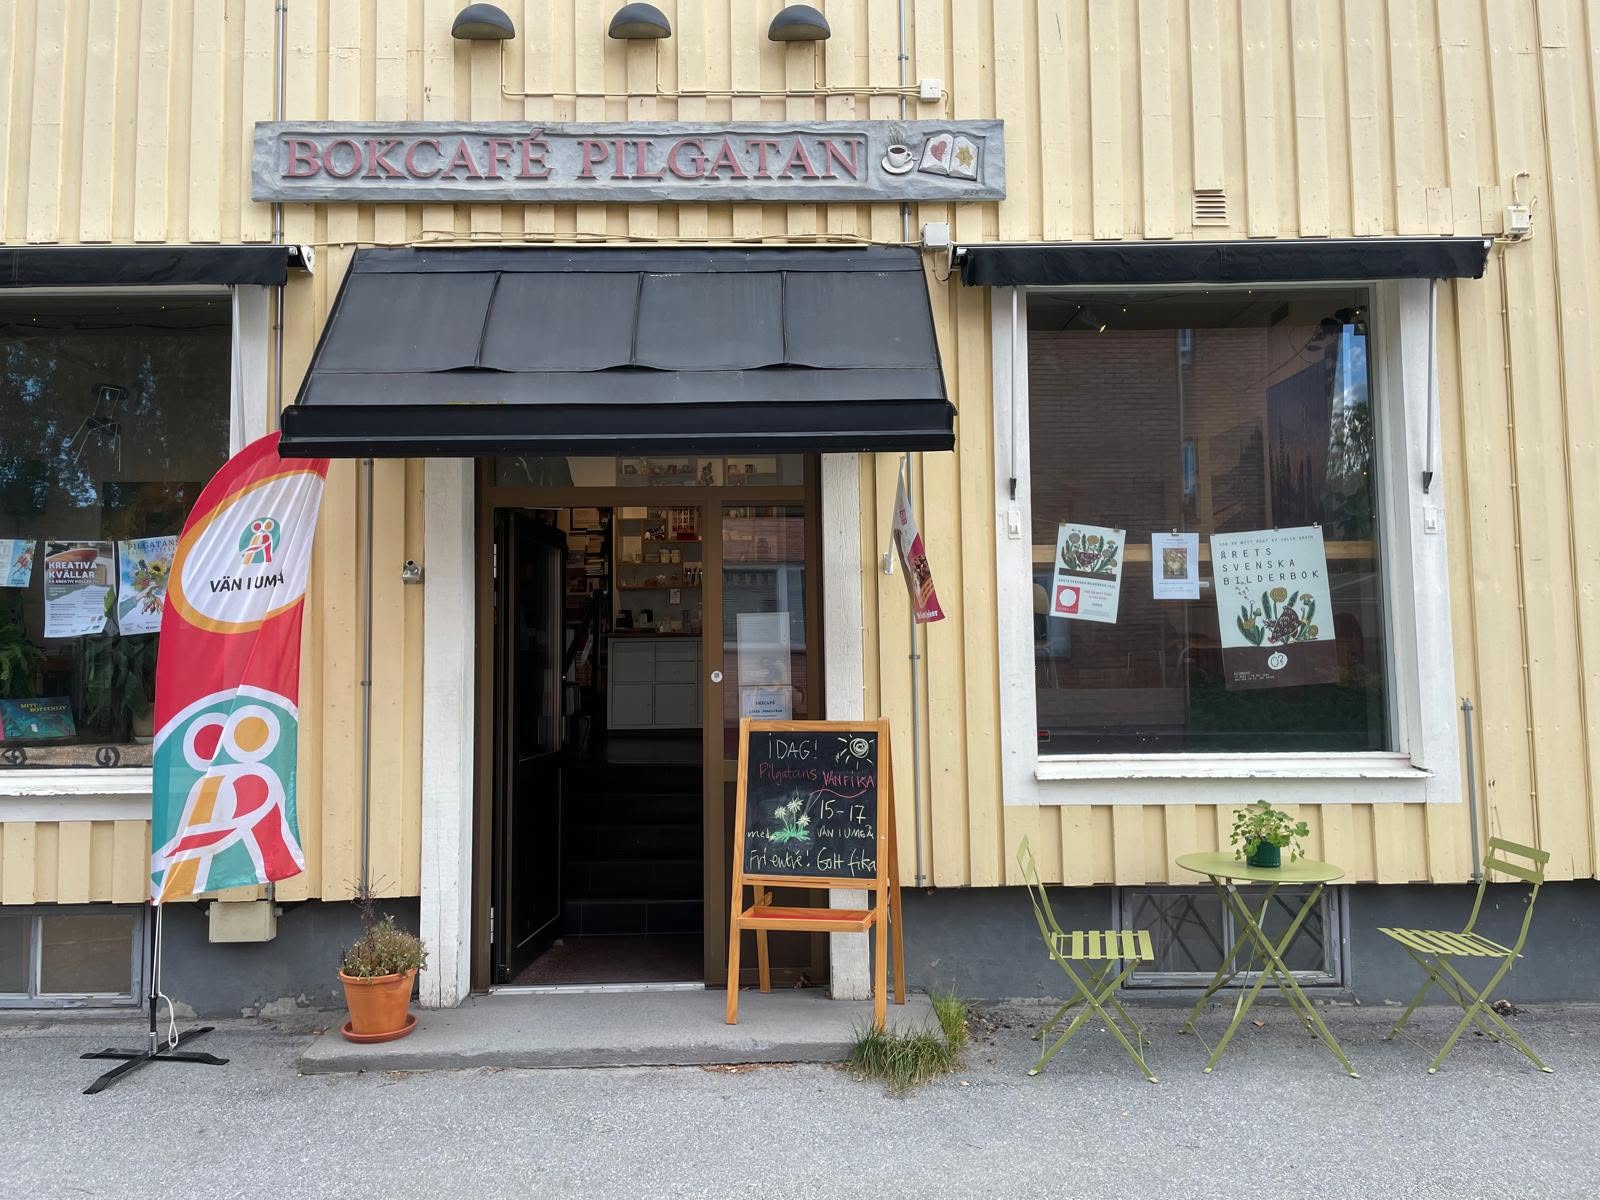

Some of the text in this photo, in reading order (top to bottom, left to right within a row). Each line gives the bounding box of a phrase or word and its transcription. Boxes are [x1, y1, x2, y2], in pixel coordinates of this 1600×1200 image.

[282, 127, 863, 180] BOKCAFÉ PILGATAN
[1221, 547, 1272, 560] ÅRETS
[48, 561, 97, 569] KREATIVA
[1222, 559, 1296, 573] SVENSKA
[48, 570, 95, 579] KVÄLLAR
[1223, 570, 1319, 586] BILDERBOK
[210, 575, 242, 592] VÄN
[247, 577, 252, 590] I
[847, 848, 877, 877] fika
